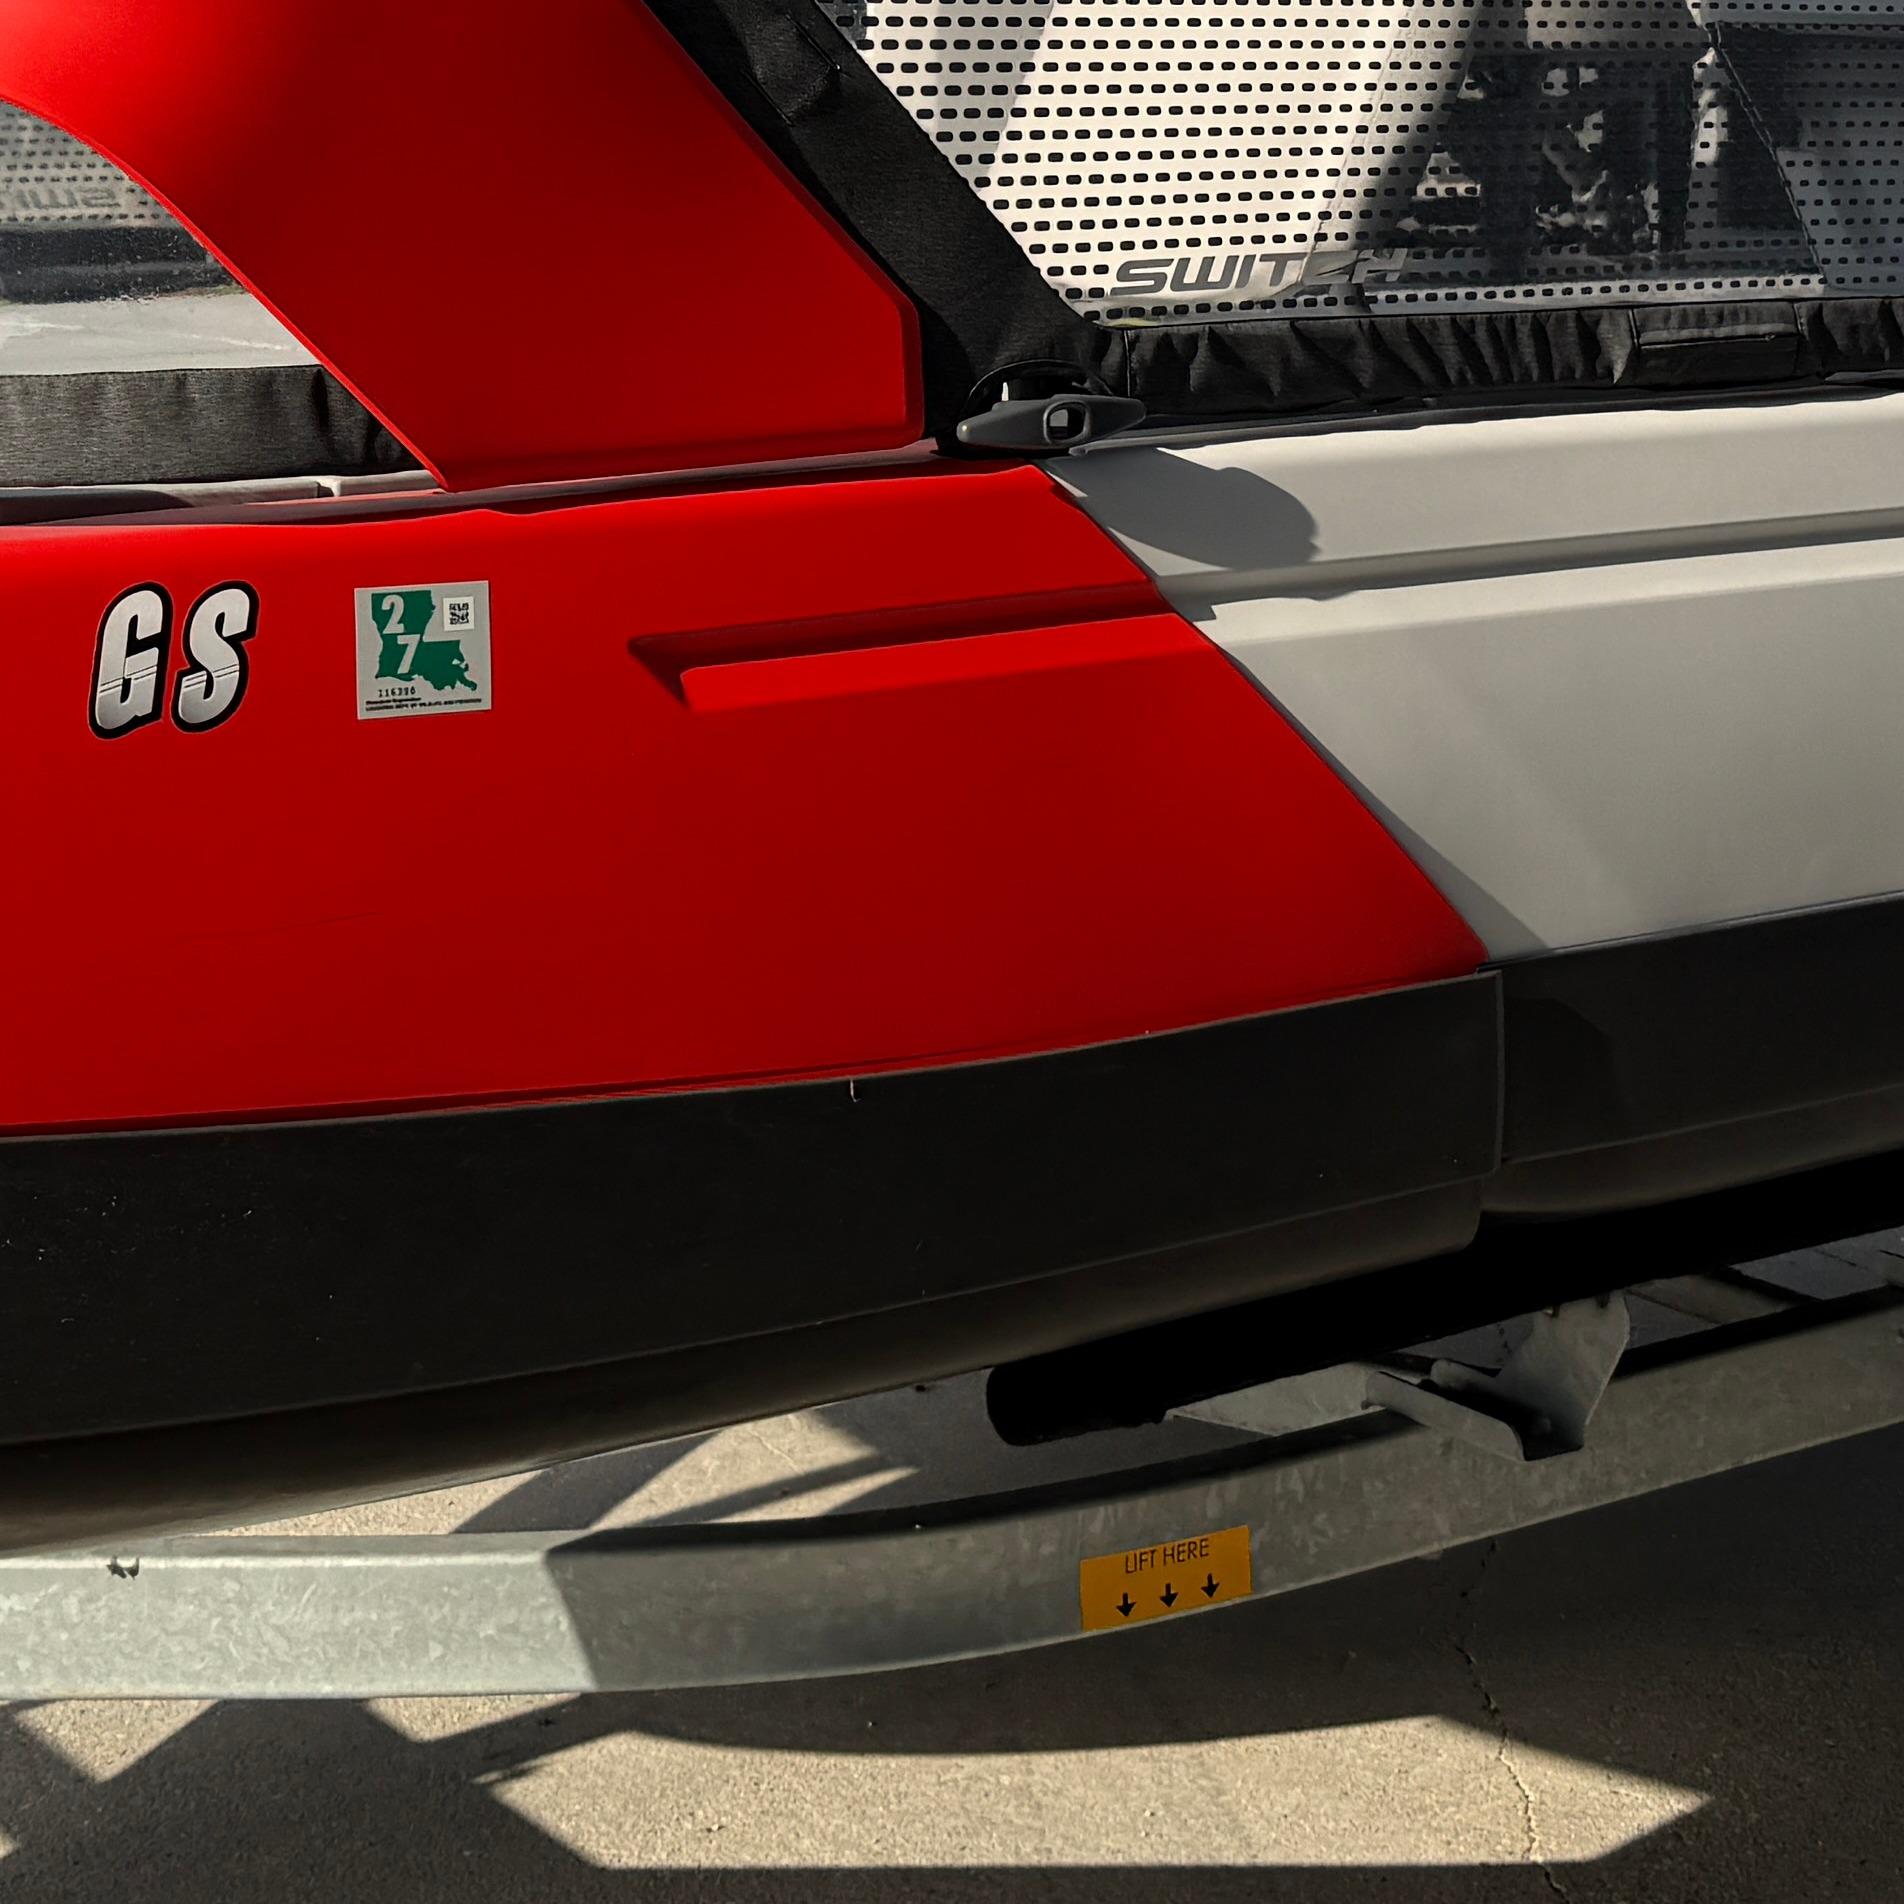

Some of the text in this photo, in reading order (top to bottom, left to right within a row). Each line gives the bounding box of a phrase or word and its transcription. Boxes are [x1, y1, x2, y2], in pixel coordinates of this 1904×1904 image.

[1109, 248, 1407, 296] SWITCH
[87, 579, 260, 740] GS
[1125, 1538, 1209, 1574] LIFT HERE
